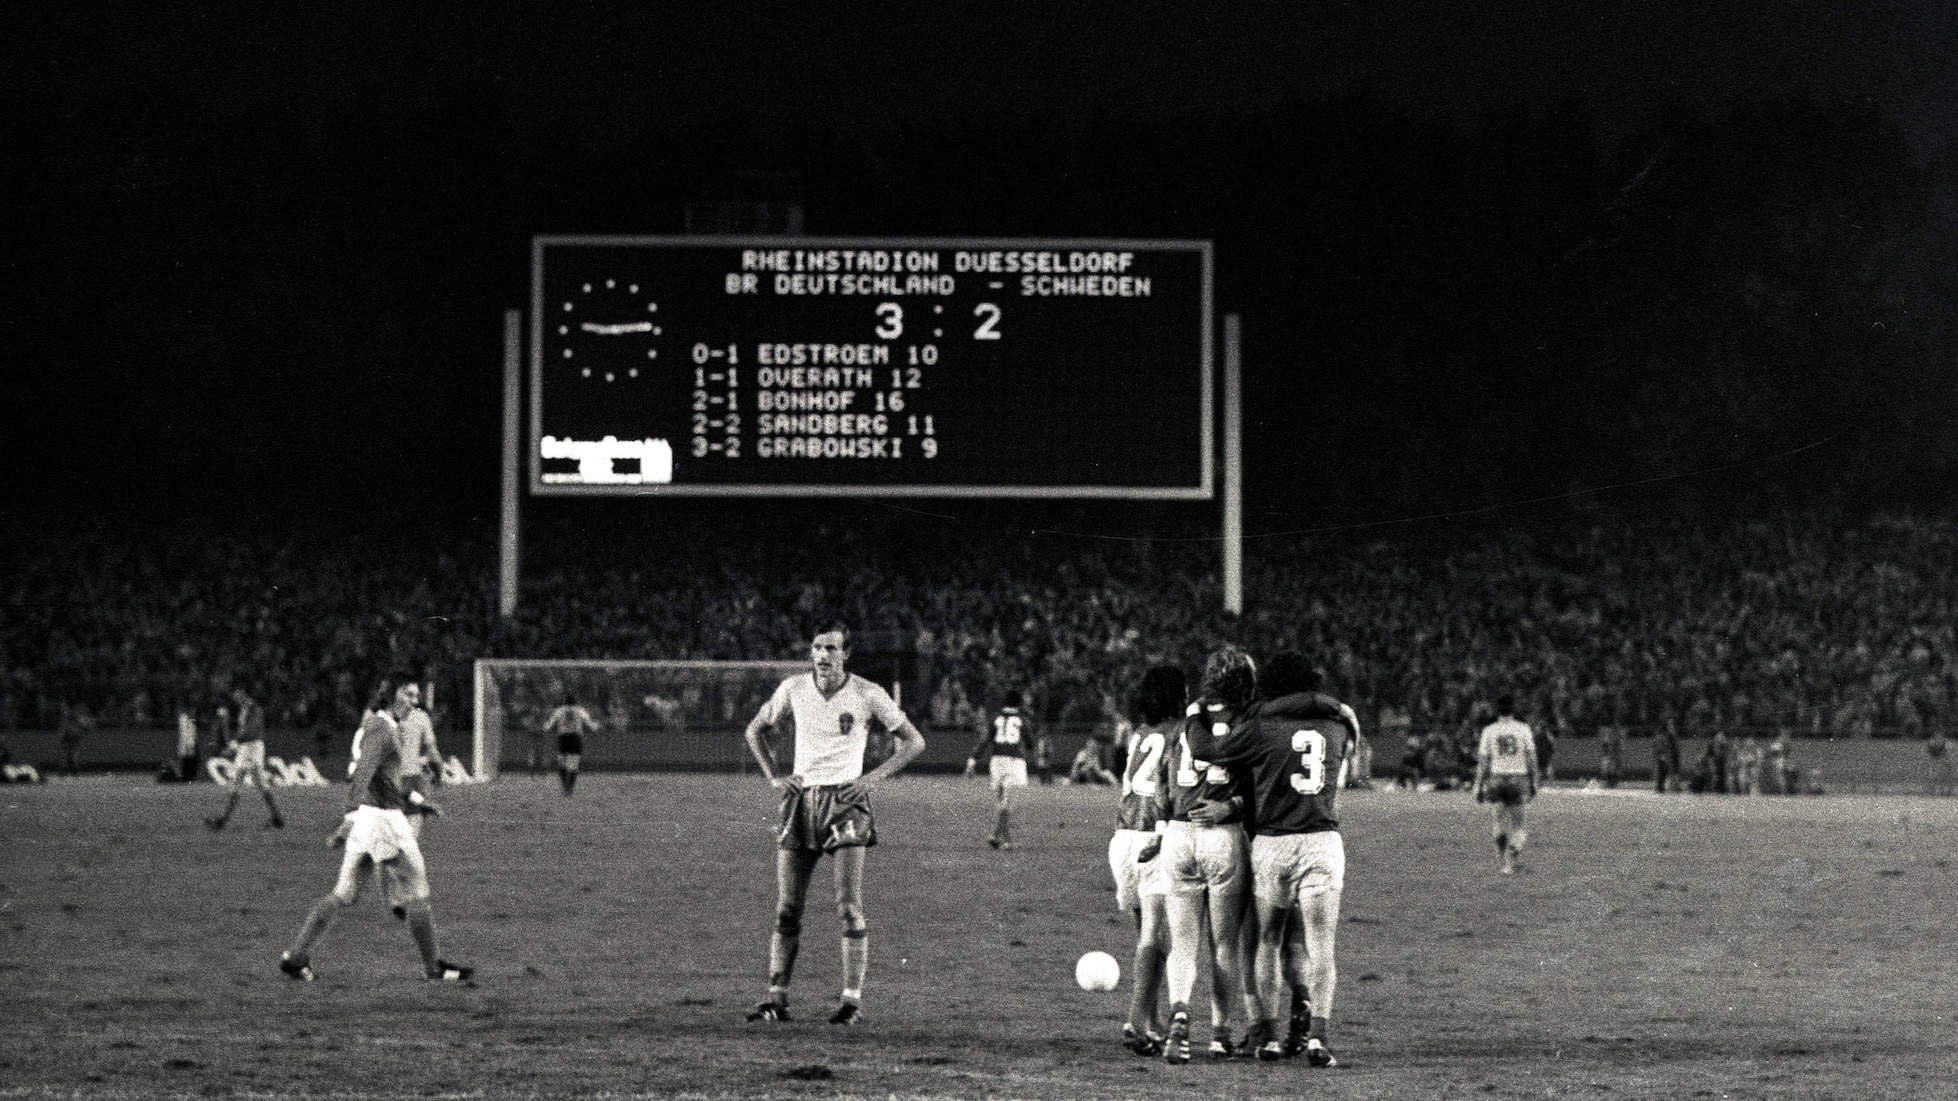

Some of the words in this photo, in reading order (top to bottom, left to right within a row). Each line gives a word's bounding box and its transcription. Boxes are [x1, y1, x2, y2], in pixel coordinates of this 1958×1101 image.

[742, 250, 939, 272] RHEINSTADION
[954, 251, 1134, 273] DUESSELDORF
[725, 273, 758, 295] BR
[774, 273, 955, 296] DEUTSCHLAND
[1021, 275, 1151, 297] SCHWEDEN
[875, 301, 904, 340] 3
[973, 302, 1002, 341] 2
[692, 343, 738, 365] 0-1
[757, 343, 890, 365] EDSTROEM
[908, 344, 939, 366] 10
[695, 366, 738, 388] 1-1
[757, 366, 873, 388] OVERATH
[892, 368, 922, 389] 12
[693, 389, 738, 411] 2-1
[757, 390, 856, 412] BONHOF
[875, 390, 905, 412] 16
[692, 412, 741, 435] 2-2
[757, 413, 889, 436] SANDBERG
[907, 414, 936, 436] 11
[692, 436, 741, 458] 3-2
[757, 436, 902, 459] GRABOWSKI
[921, 437, 938, 459] 9
[1122, 733, 1165, 797] 12
[1290, 729, 1326, 795] 3
